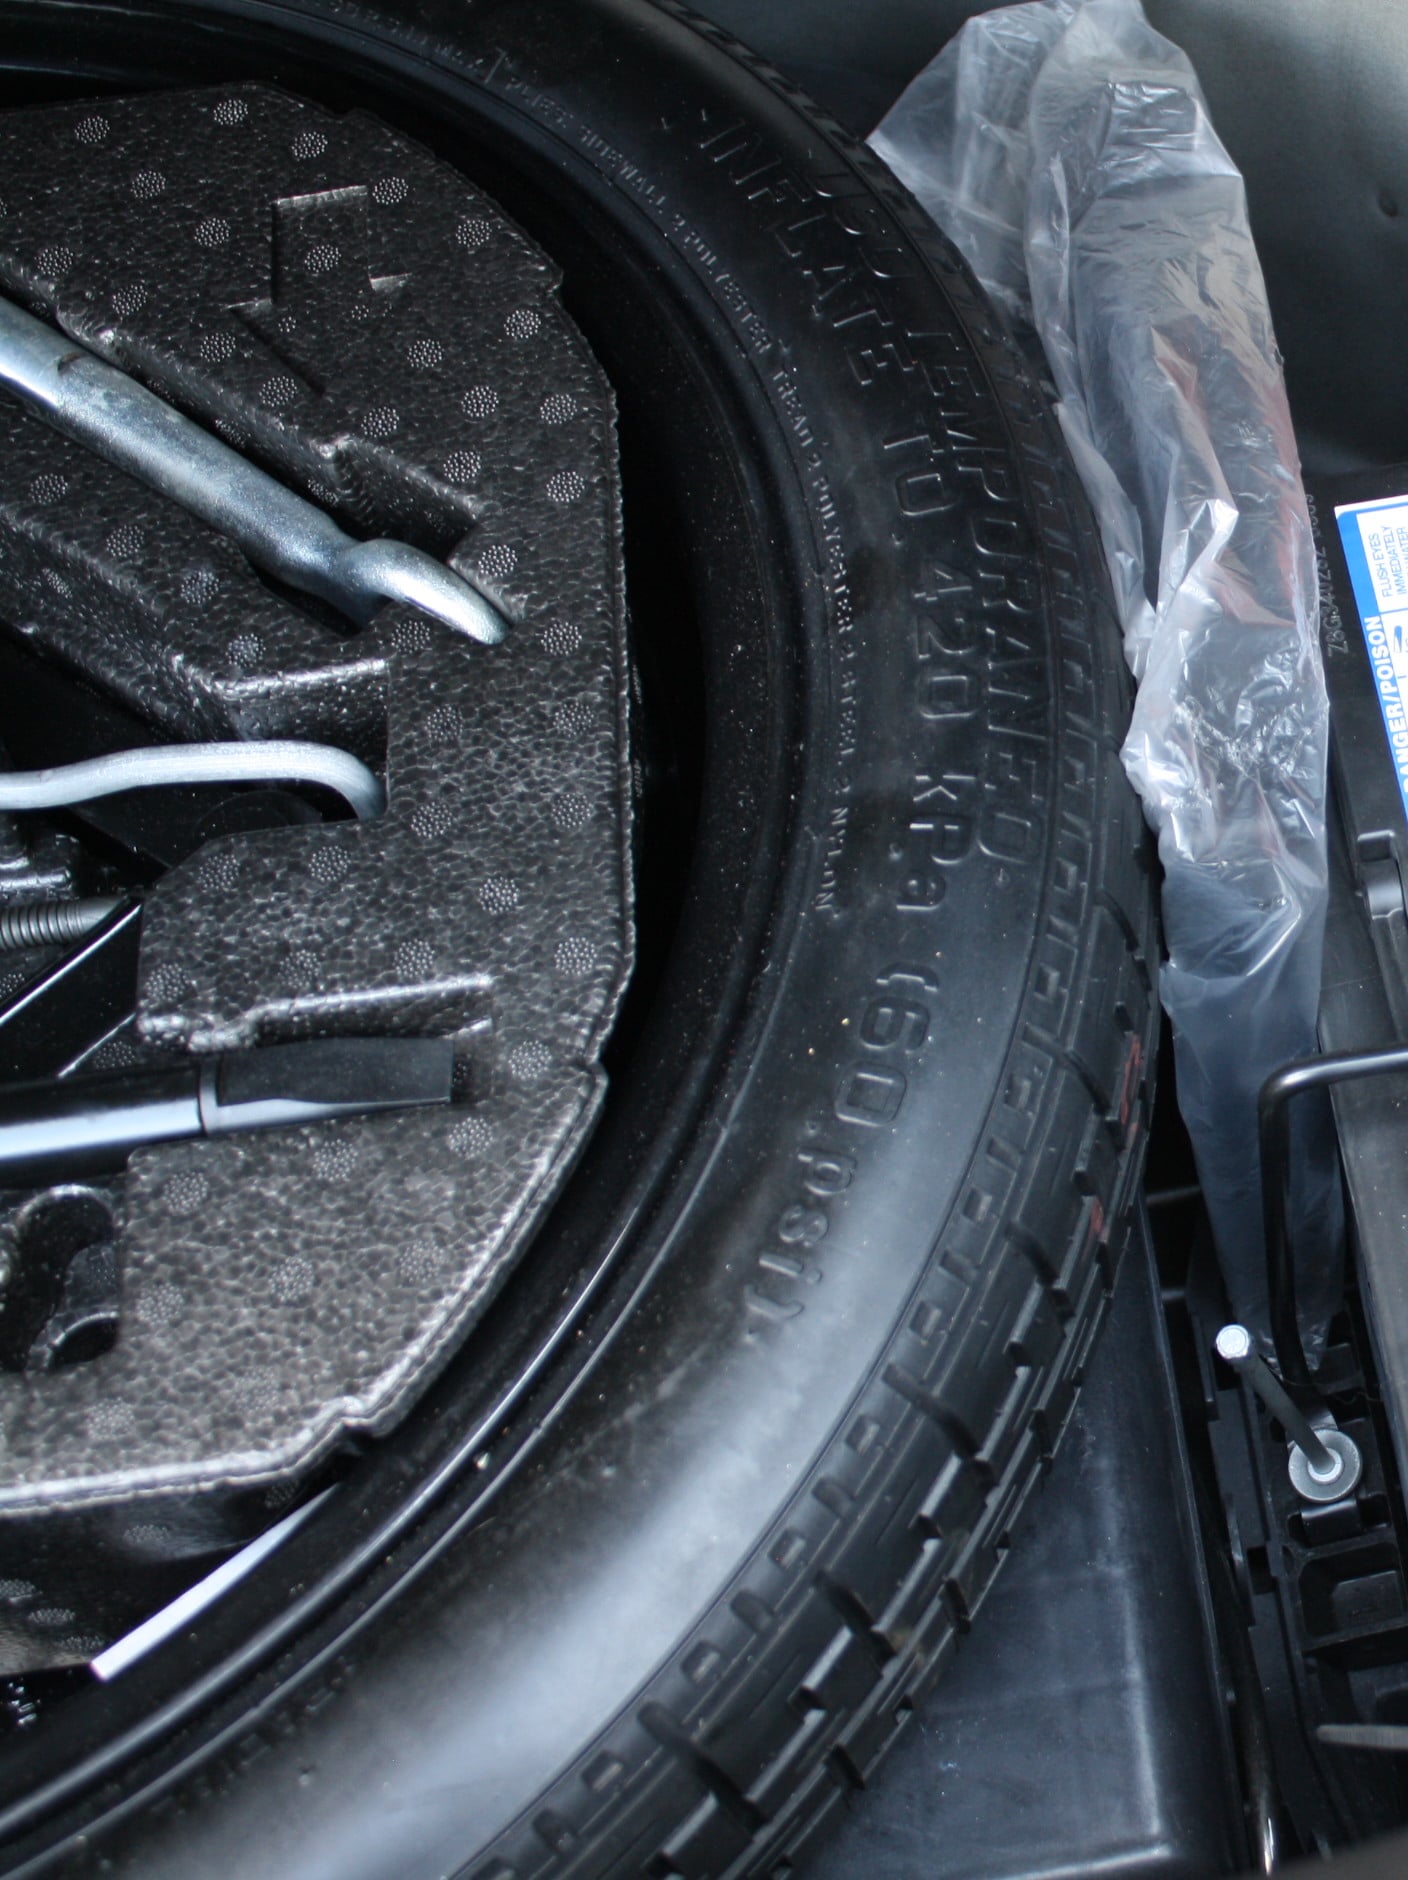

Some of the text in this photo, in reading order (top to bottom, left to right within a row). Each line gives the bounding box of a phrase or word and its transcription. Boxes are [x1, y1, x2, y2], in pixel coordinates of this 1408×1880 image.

[1368, 533, 1391, 597] FLUSH EYES
[1383, 526, 1406, 594] IMMEDIATELY
[698, 116, 982, 1318] INFLATE TO 420 kPa (60 psi)
